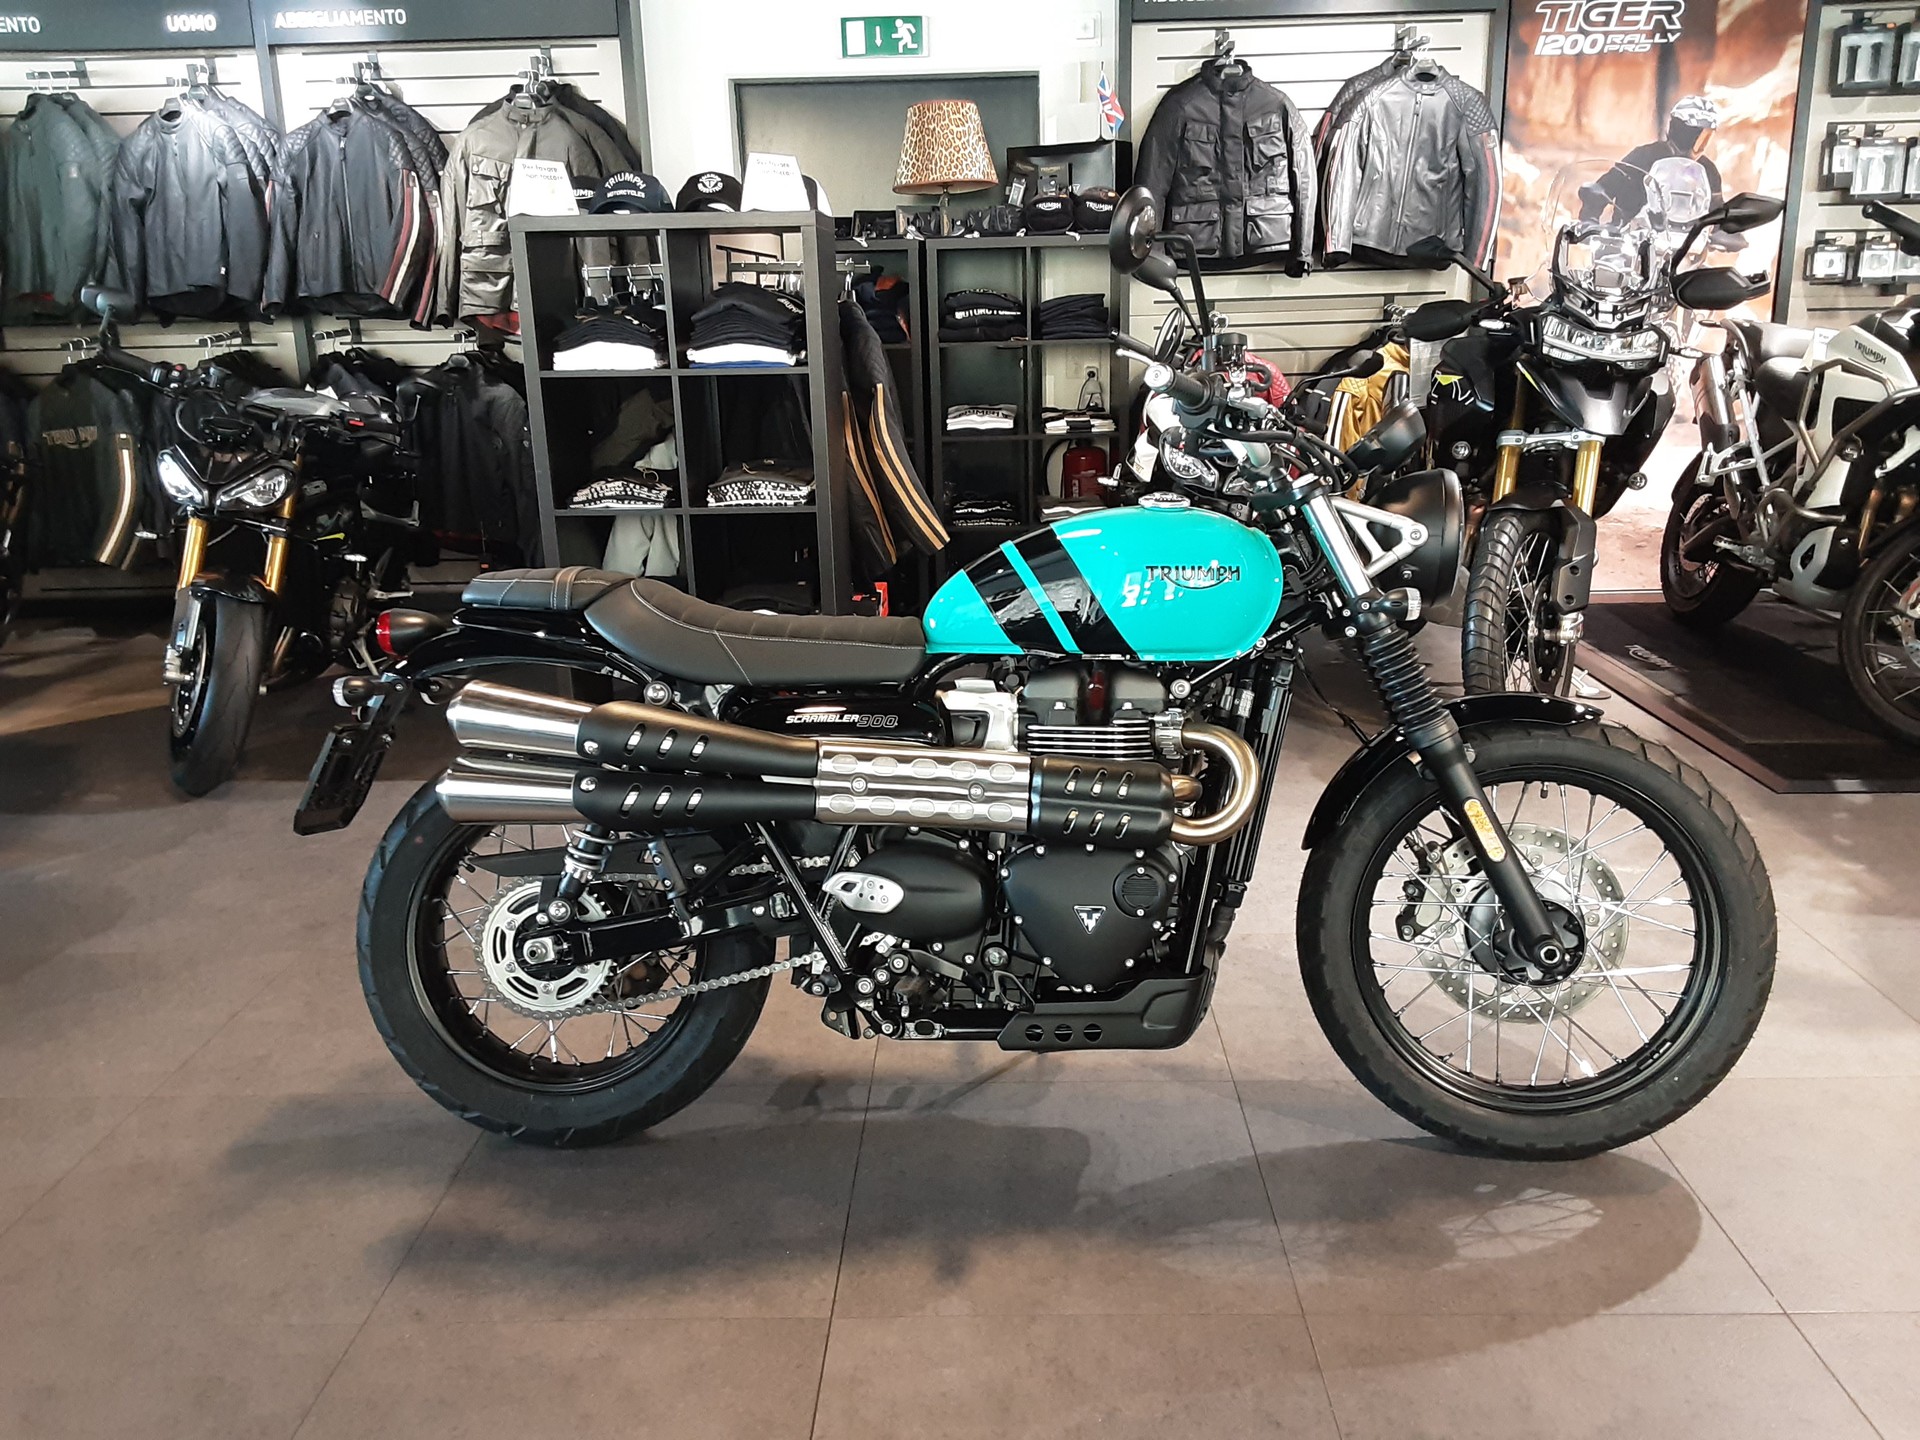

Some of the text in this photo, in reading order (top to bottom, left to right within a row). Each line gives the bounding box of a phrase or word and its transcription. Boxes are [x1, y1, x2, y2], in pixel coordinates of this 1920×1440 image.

[166, 14, 217, 32] UOMO
[1535, 0, 1685, 33] TIGER
[1534, 33, 1682, 56] 1200 RALLY
[1603, 44, 1652, 53] PRO
[604, 172, 647, 190] TRIUMPH
[1853, 339, 1887, 365] TRIUMPH
[1145, 564, 1240, 590] TRIUMPH
[785, 714, 899, 728] SCRAMBLER 900
